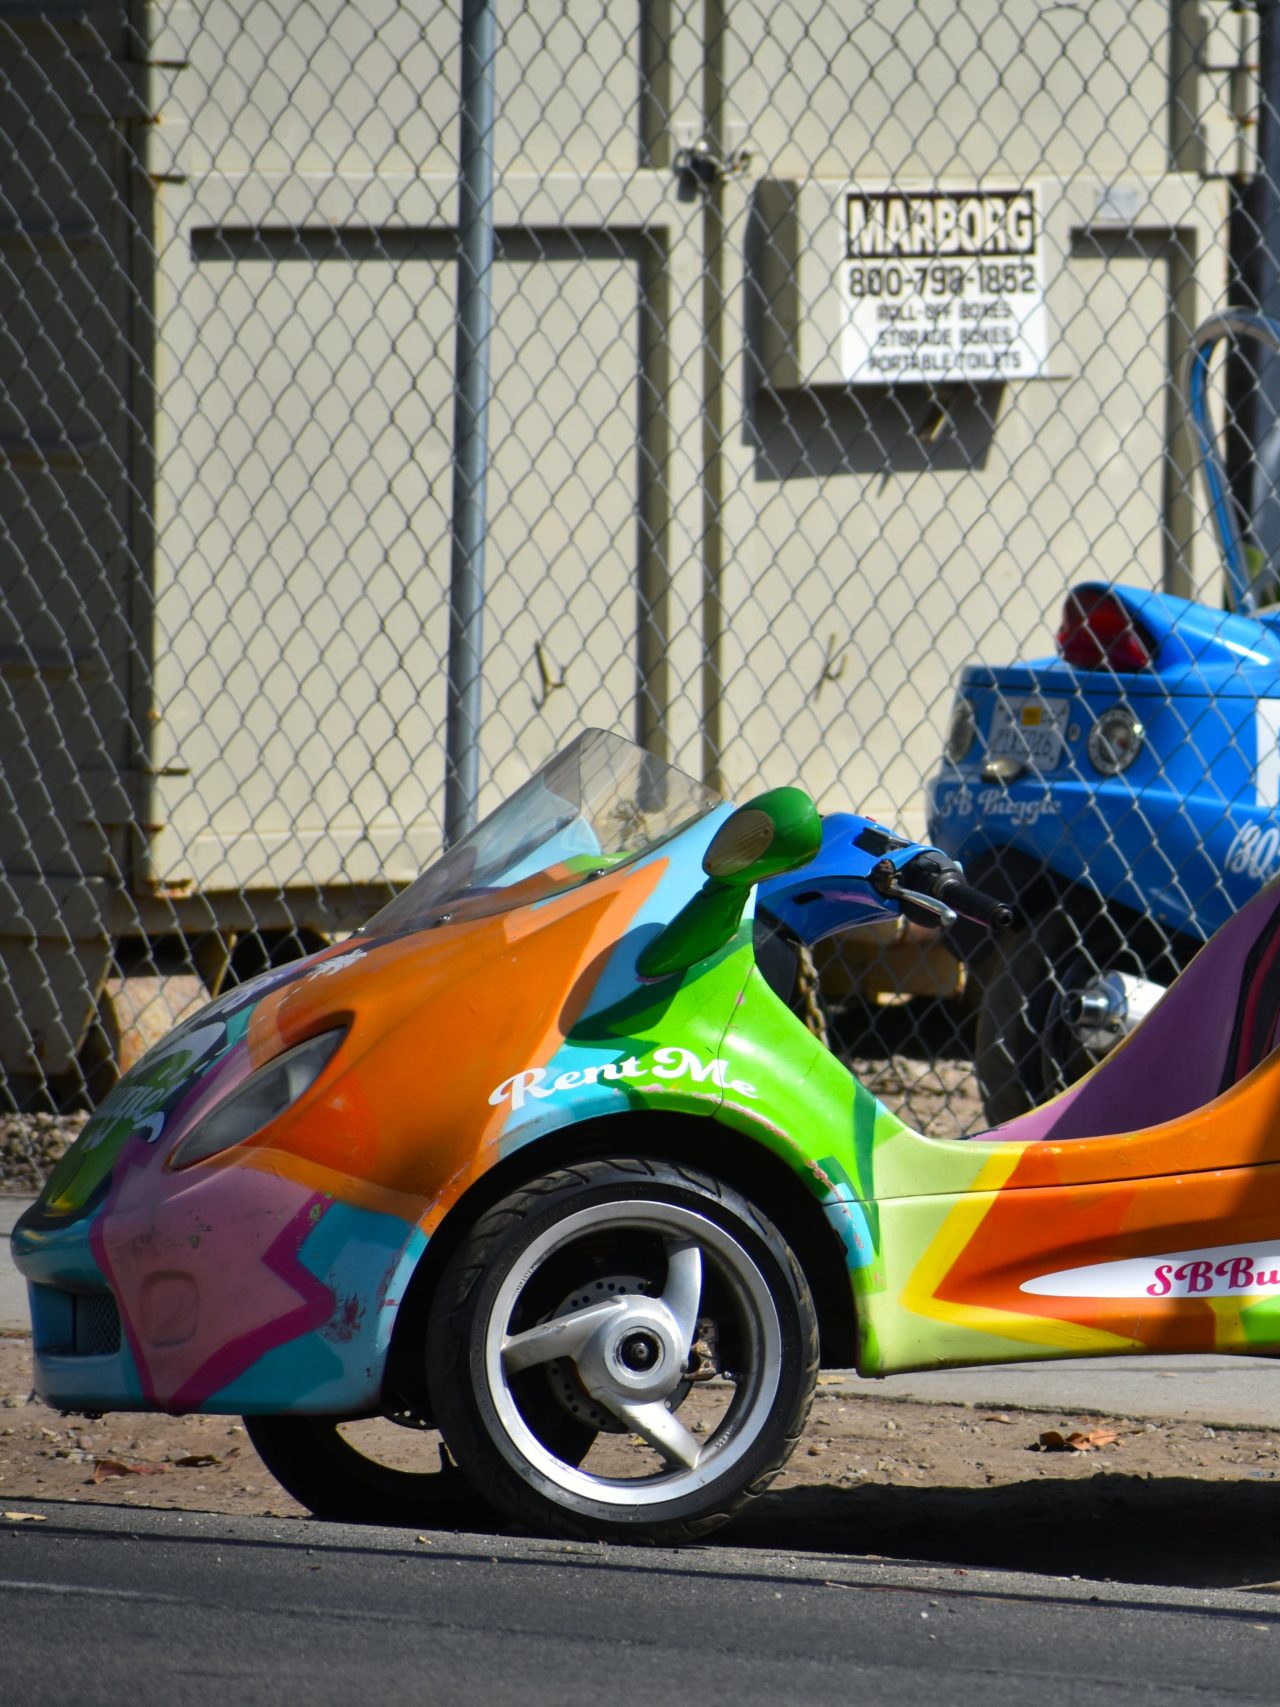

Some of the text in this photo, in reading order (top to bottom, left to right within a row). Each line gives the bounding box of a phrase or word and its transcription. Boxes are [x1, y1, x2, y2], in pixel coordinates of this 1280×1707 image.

[849, 197, 1034, 255] MARBORG
[958, 301, 1012, 320] BOXES
[487, 1046, 760, 1111] Rent Me
